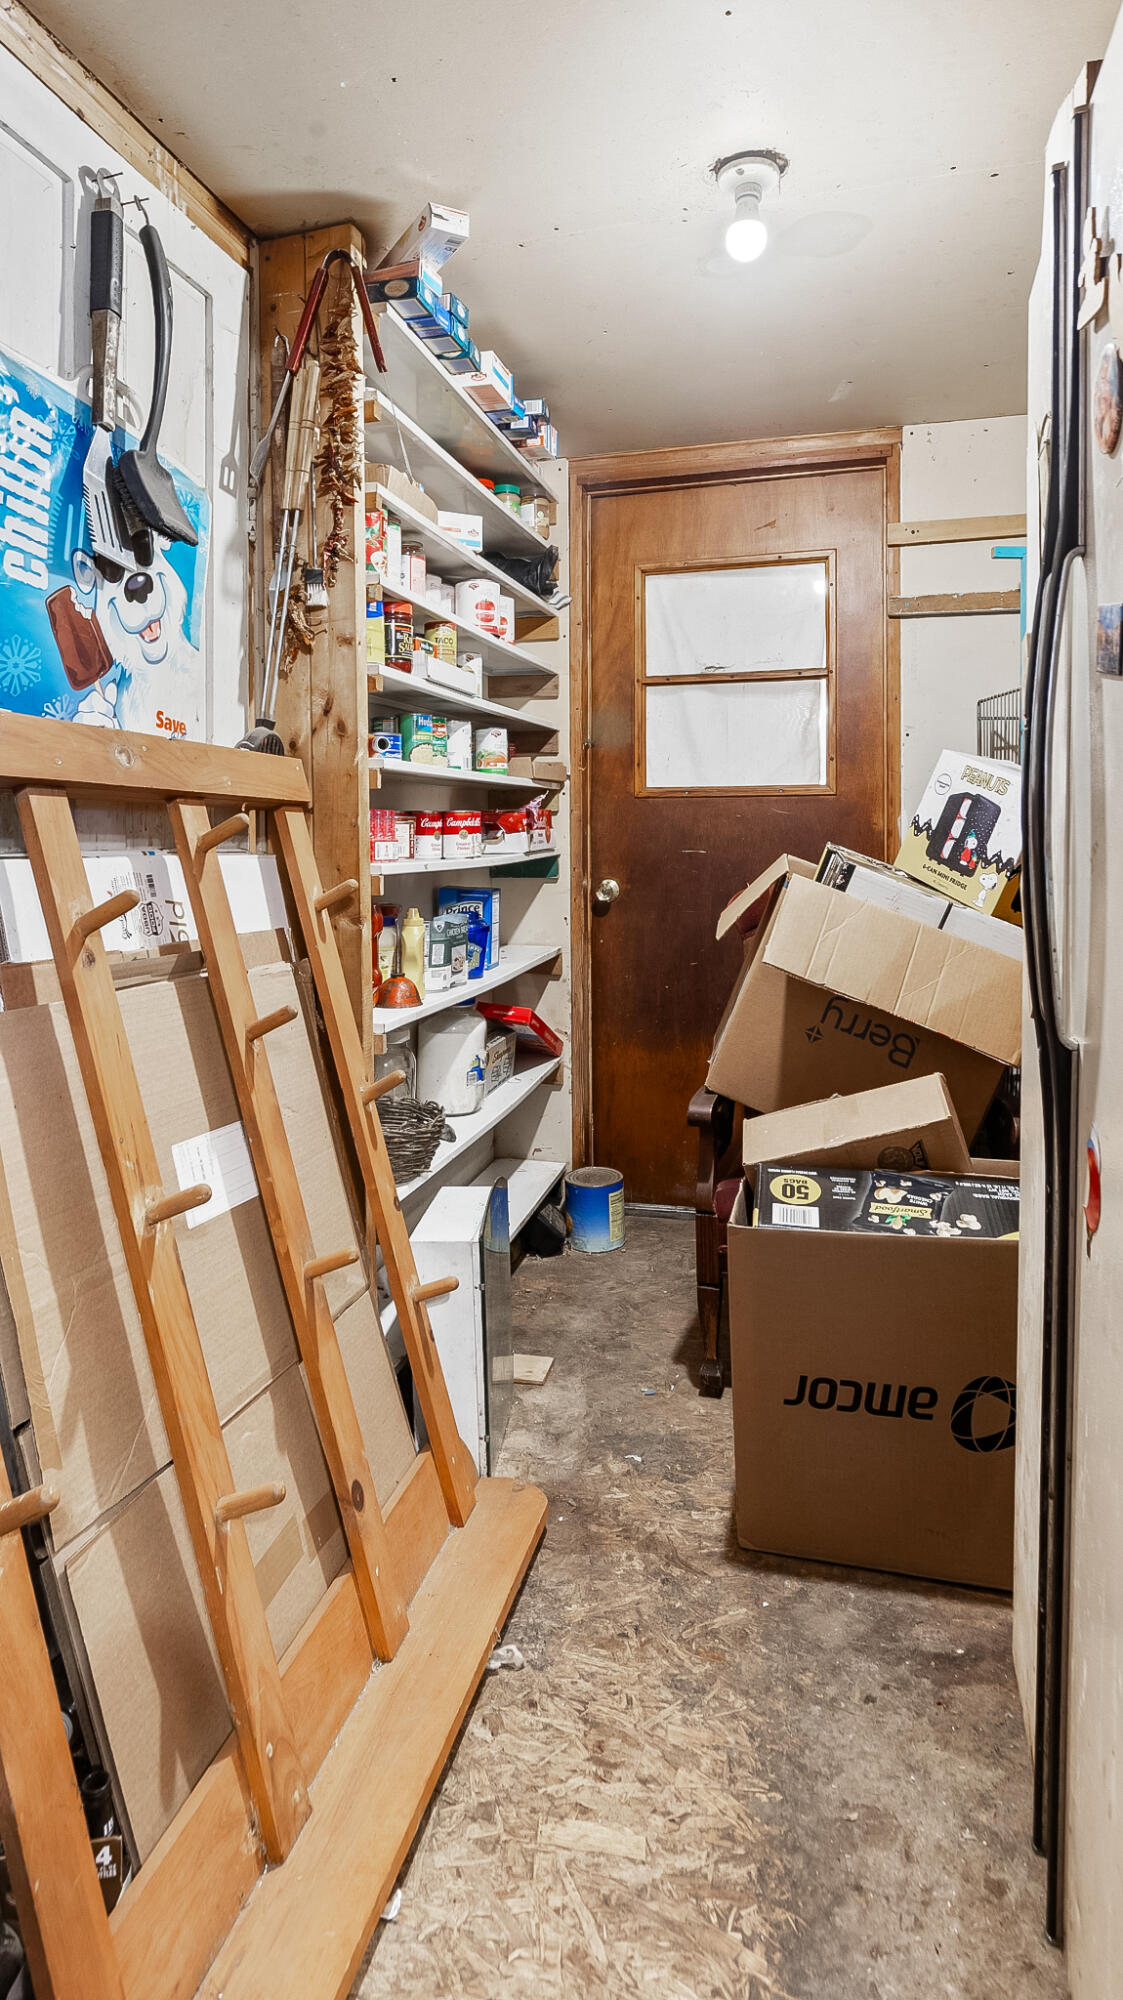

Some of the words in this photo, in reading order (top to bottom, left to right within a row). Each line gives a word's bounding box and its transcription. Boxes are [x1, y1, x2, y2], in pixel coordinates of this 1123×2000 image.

[434, 637, 454, 645] TACO
[155, 710, 187, 736] Save
[961, 764, 1011, 796] PEANUTS
[937, 869, 950, 881] MINI
[950, 875, 968, 891] FRIDGE
[445, 903, 480, 915] Prince
[821, 996, 917, 1069] Berry
[781, 1184, 810, 1200] 50
[906, 1194, 933, 1204] CHEDDAR
[874, 1205, 928, 1216] Smartfood
[909, 1199, 928, 1207] WHITE
[783, 1375, 938, 1421] amcor
[95, 1844, 113, 1866] 4
